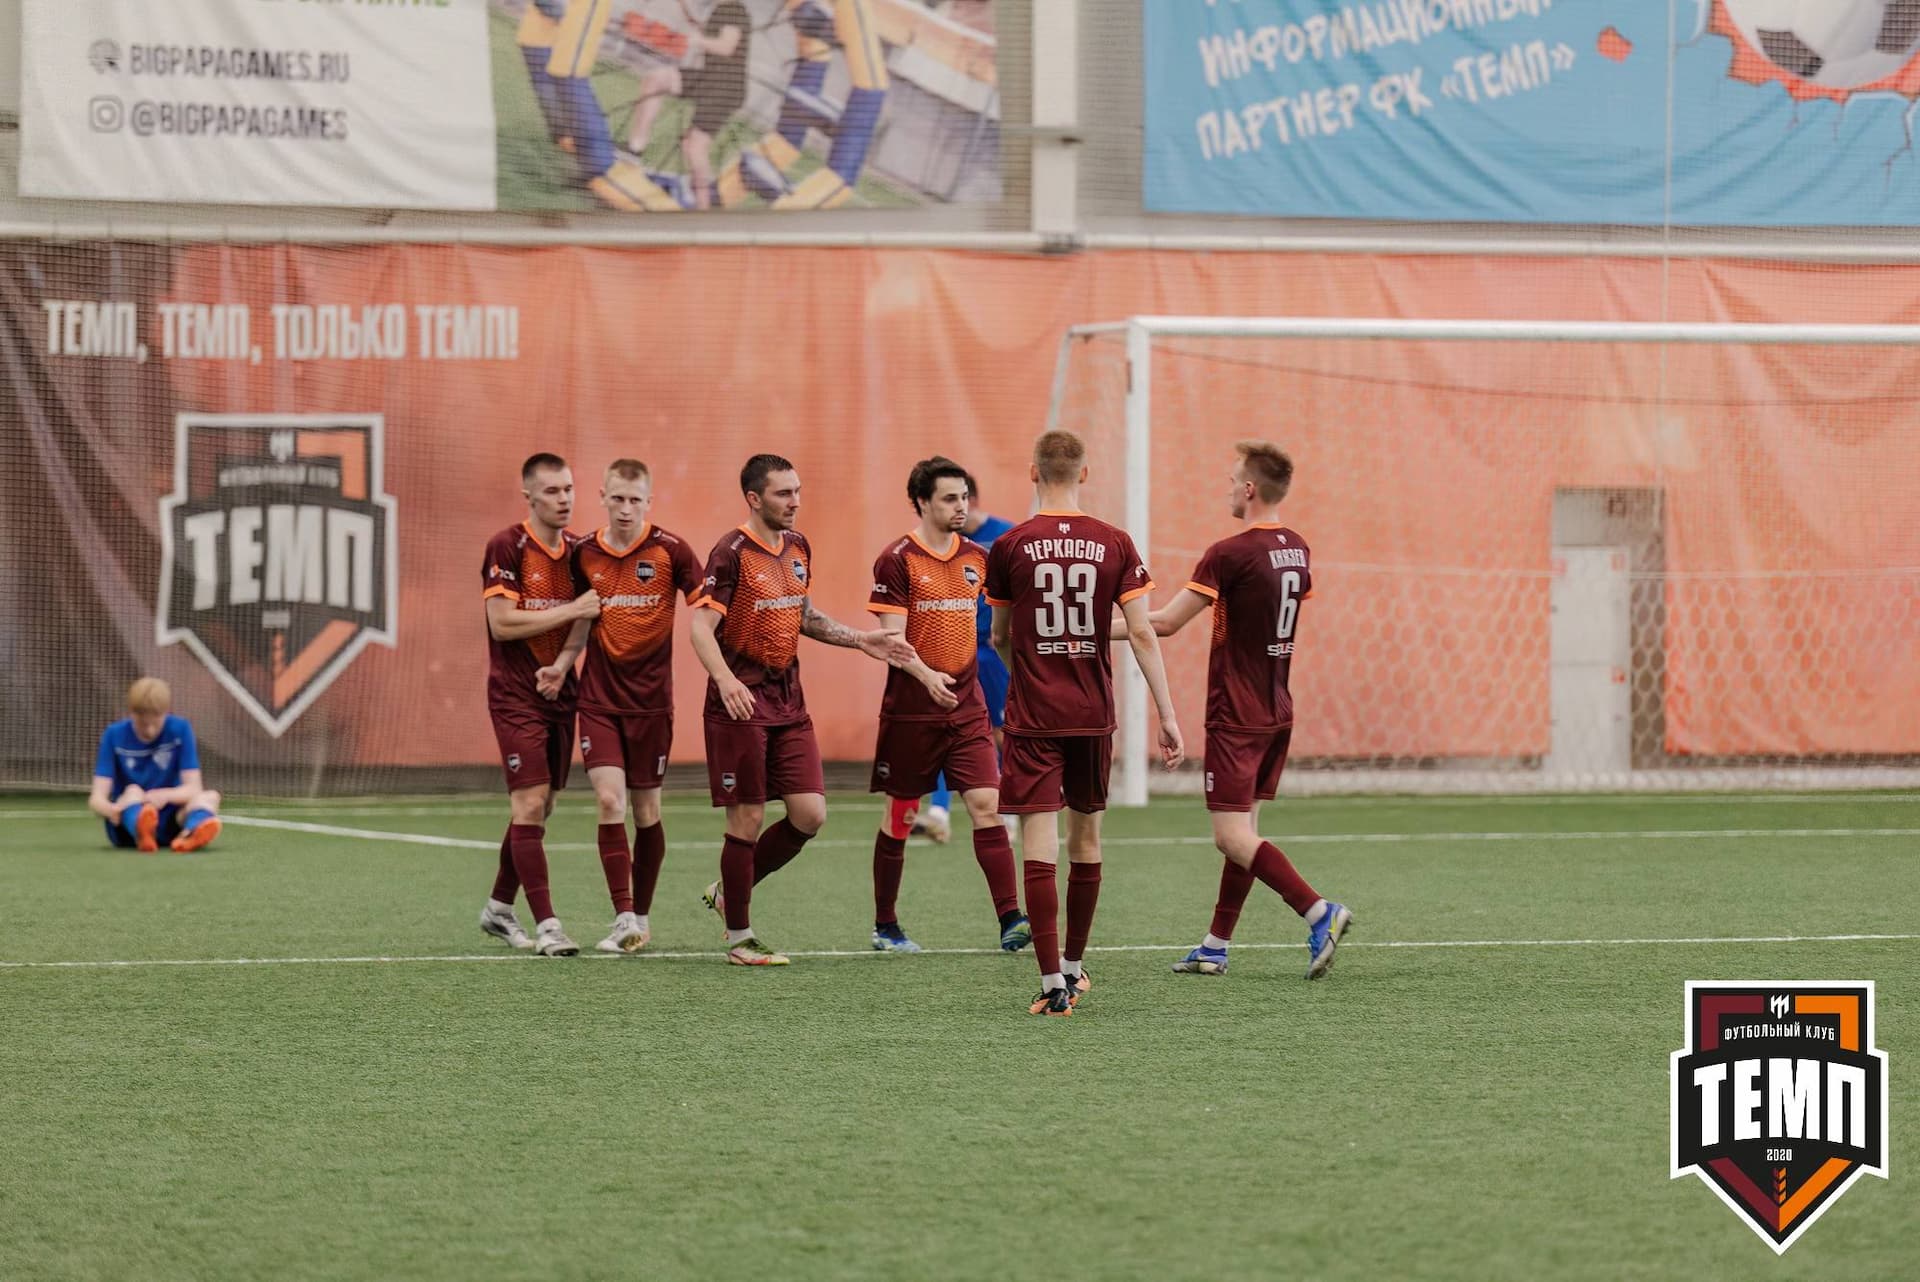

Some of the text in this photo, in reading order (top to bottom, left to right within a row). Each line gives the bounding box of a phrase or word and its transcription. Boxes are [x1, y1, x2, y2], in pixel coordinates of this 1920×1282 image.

[130, 43, 350, 84] BIGPAPAGAMES.RU
[131, 100, 347, 141] @BIGPAPAGAMES
[1196, 39, 1576, 160] ПАРТНЕР ФК «ТЕМП»
[42, 300, 519, 365] ТЕМП, ТЕМП, ТОЛЬКО ТЕМП!
[184, 504, 374, 612] ТЕМП
[1023, 538, 1106, 563] ЧЕРКАСОВ
[1034, 563, 1098, 637] 33
[1276, 570, 1301, 639] 6
[1036, 641, 1097, 655] SEUS
